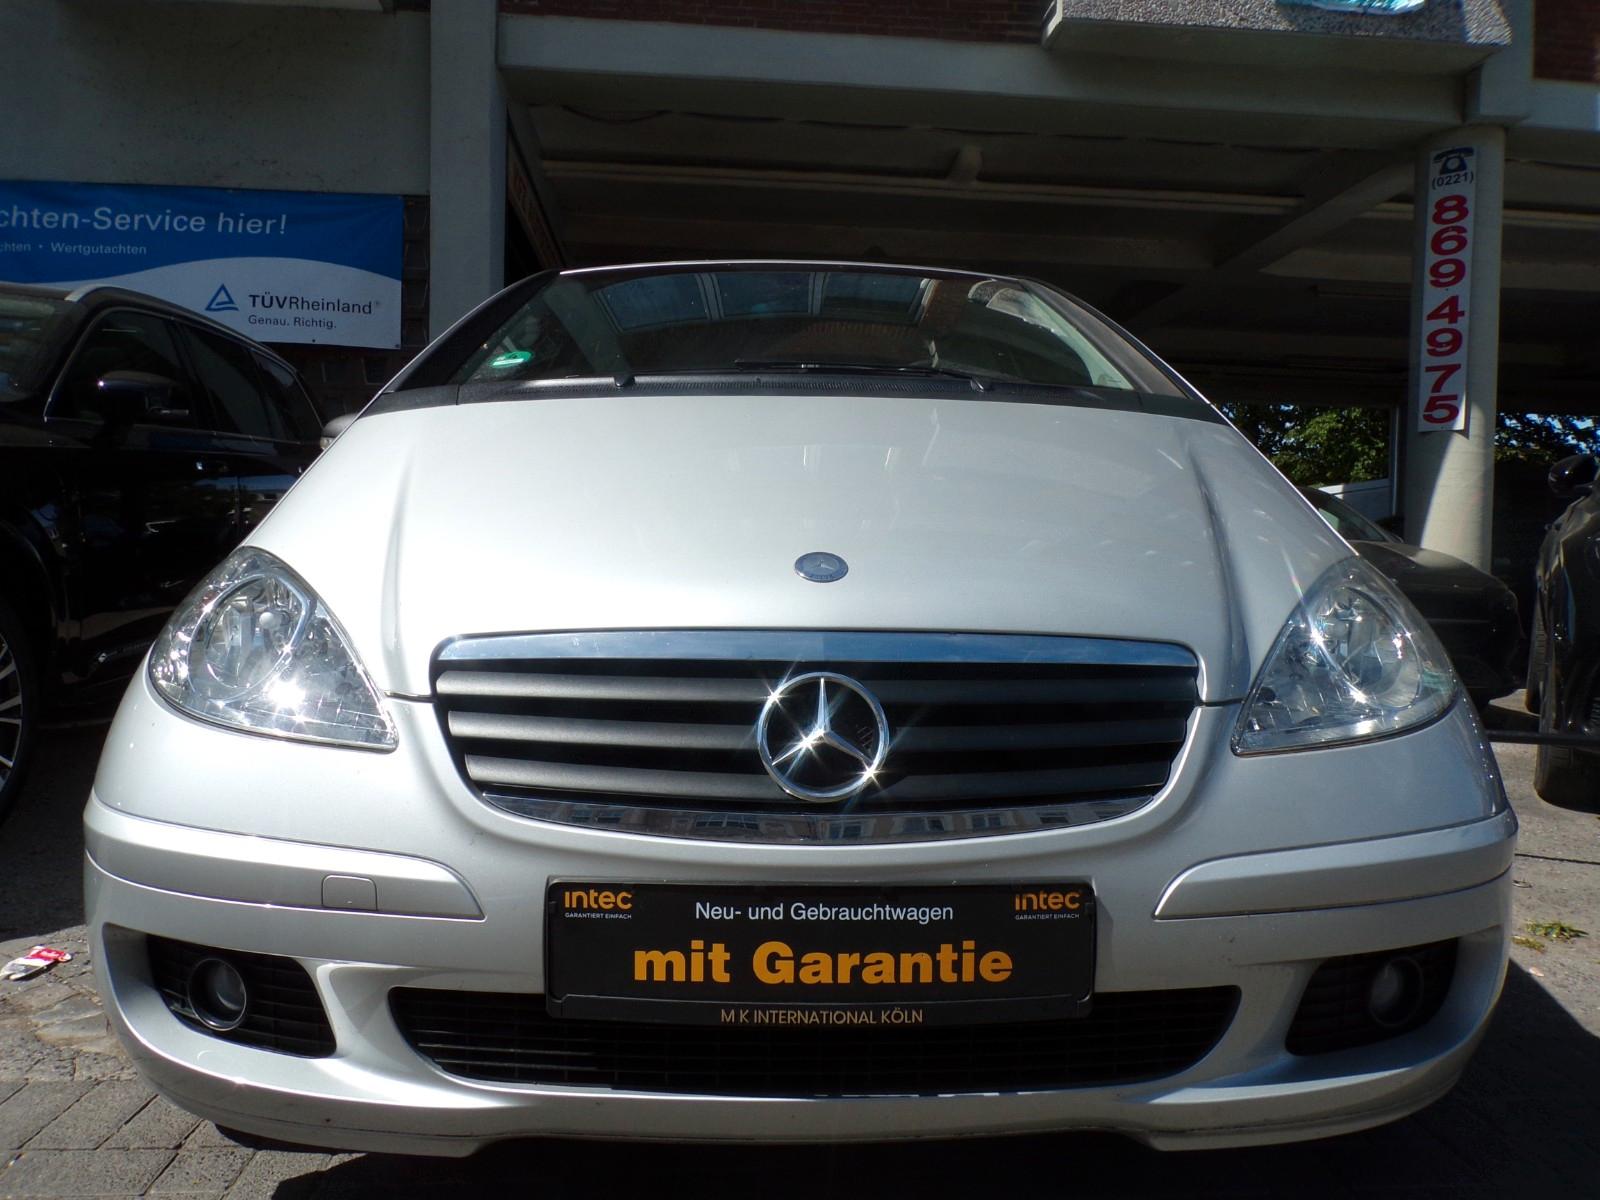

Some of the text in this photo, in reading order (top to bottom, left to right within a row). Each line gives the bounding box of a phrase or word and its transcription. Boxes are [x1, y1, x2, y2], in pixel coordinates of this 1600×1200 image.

[1432, 172, 1474, 190] (0221)
[217, 212, 287, 235] hier!
[50, 241, 147, 256] Wertgutachten
[248, 314, 337, 330] Genau. Richtig.
[564, 889, 633, 910] intec
[1014, 890, 1081, 911] intec
[695, 902, 954, 925] Neu- und Gebrauchtwagen
[633, 940, 1014, 985] mit Garantie
[754, 1009, 876, 1025] INTERNATIONAL
[881, 1006, 923, 1025] KÖLN
